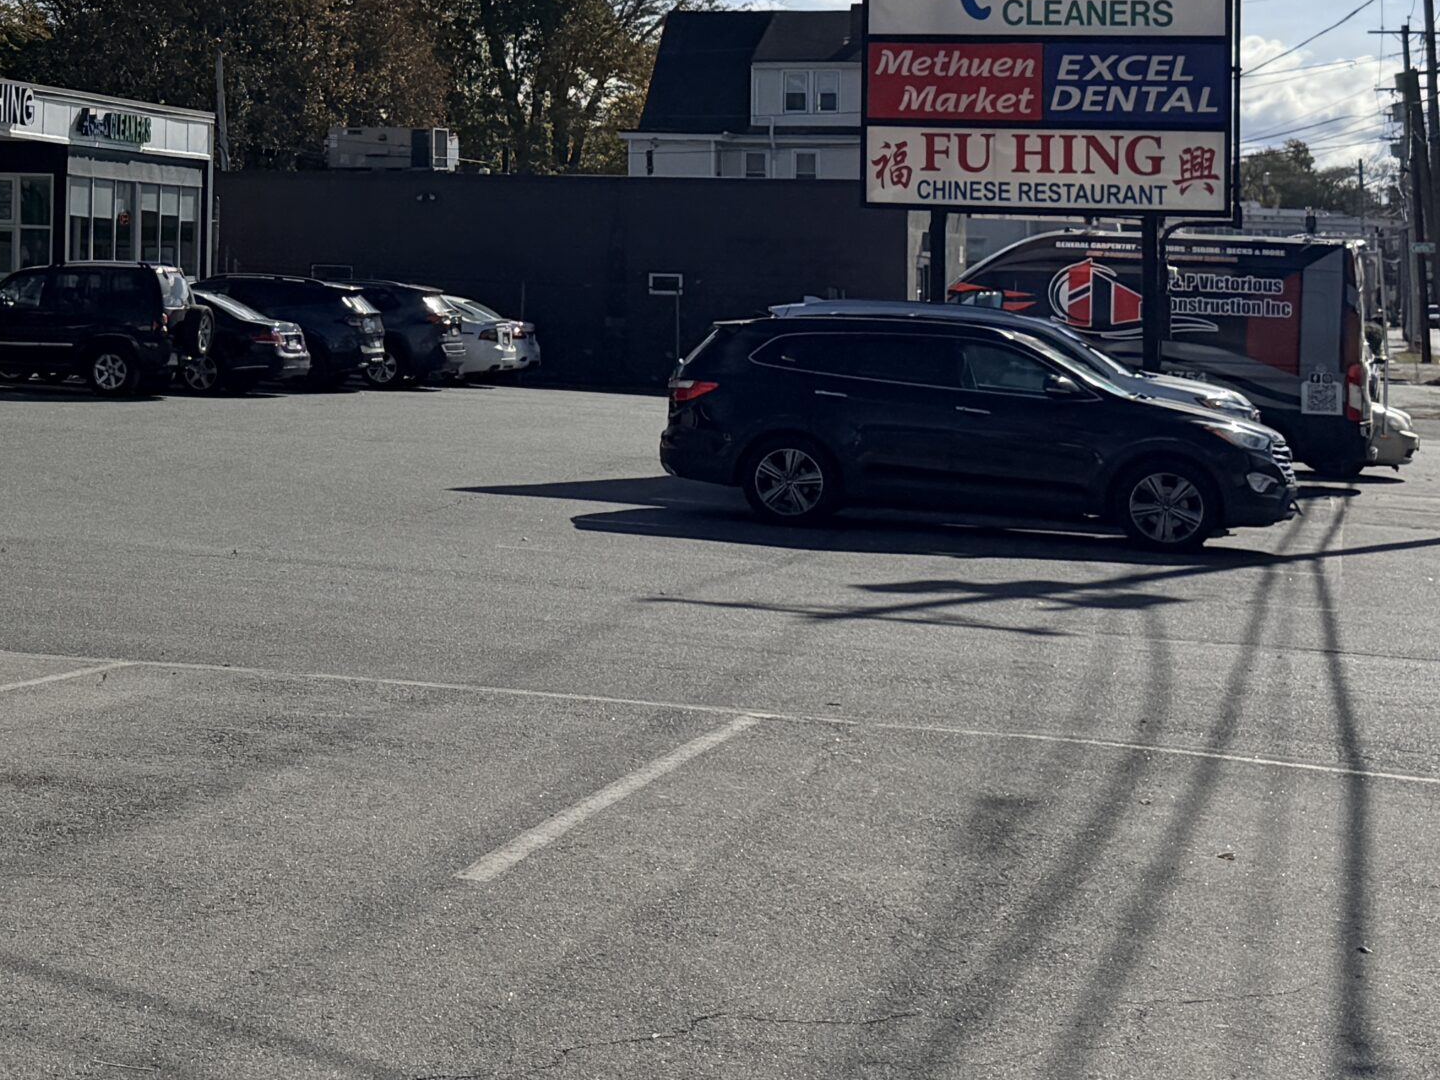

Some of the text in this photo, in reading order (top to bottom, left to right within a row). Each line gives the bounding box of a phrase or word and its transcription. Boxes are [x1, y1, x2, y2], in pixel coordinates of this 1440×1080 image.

[875, 49, 1035, 78] Methuen
[1056, 54, 1195, 82] EXCEL
[898, 85, 1035, 114] Market
[1050, 85, 1219, 113] DENTAL
[110, 112, 152, 143] CLEANERS
[871, 140, 913, 190] 福
[920, 132, 1166, 177] FU HING
[1172, 145, 1221, 196] 興
[917, 179, 1169, 206] CHINESE RESTAURANT
[1185, 273, 1201, 292] P
[1200, 273, 1284, 295] Victorious
[1170, 296, 1293, 318] onstruction Inc
